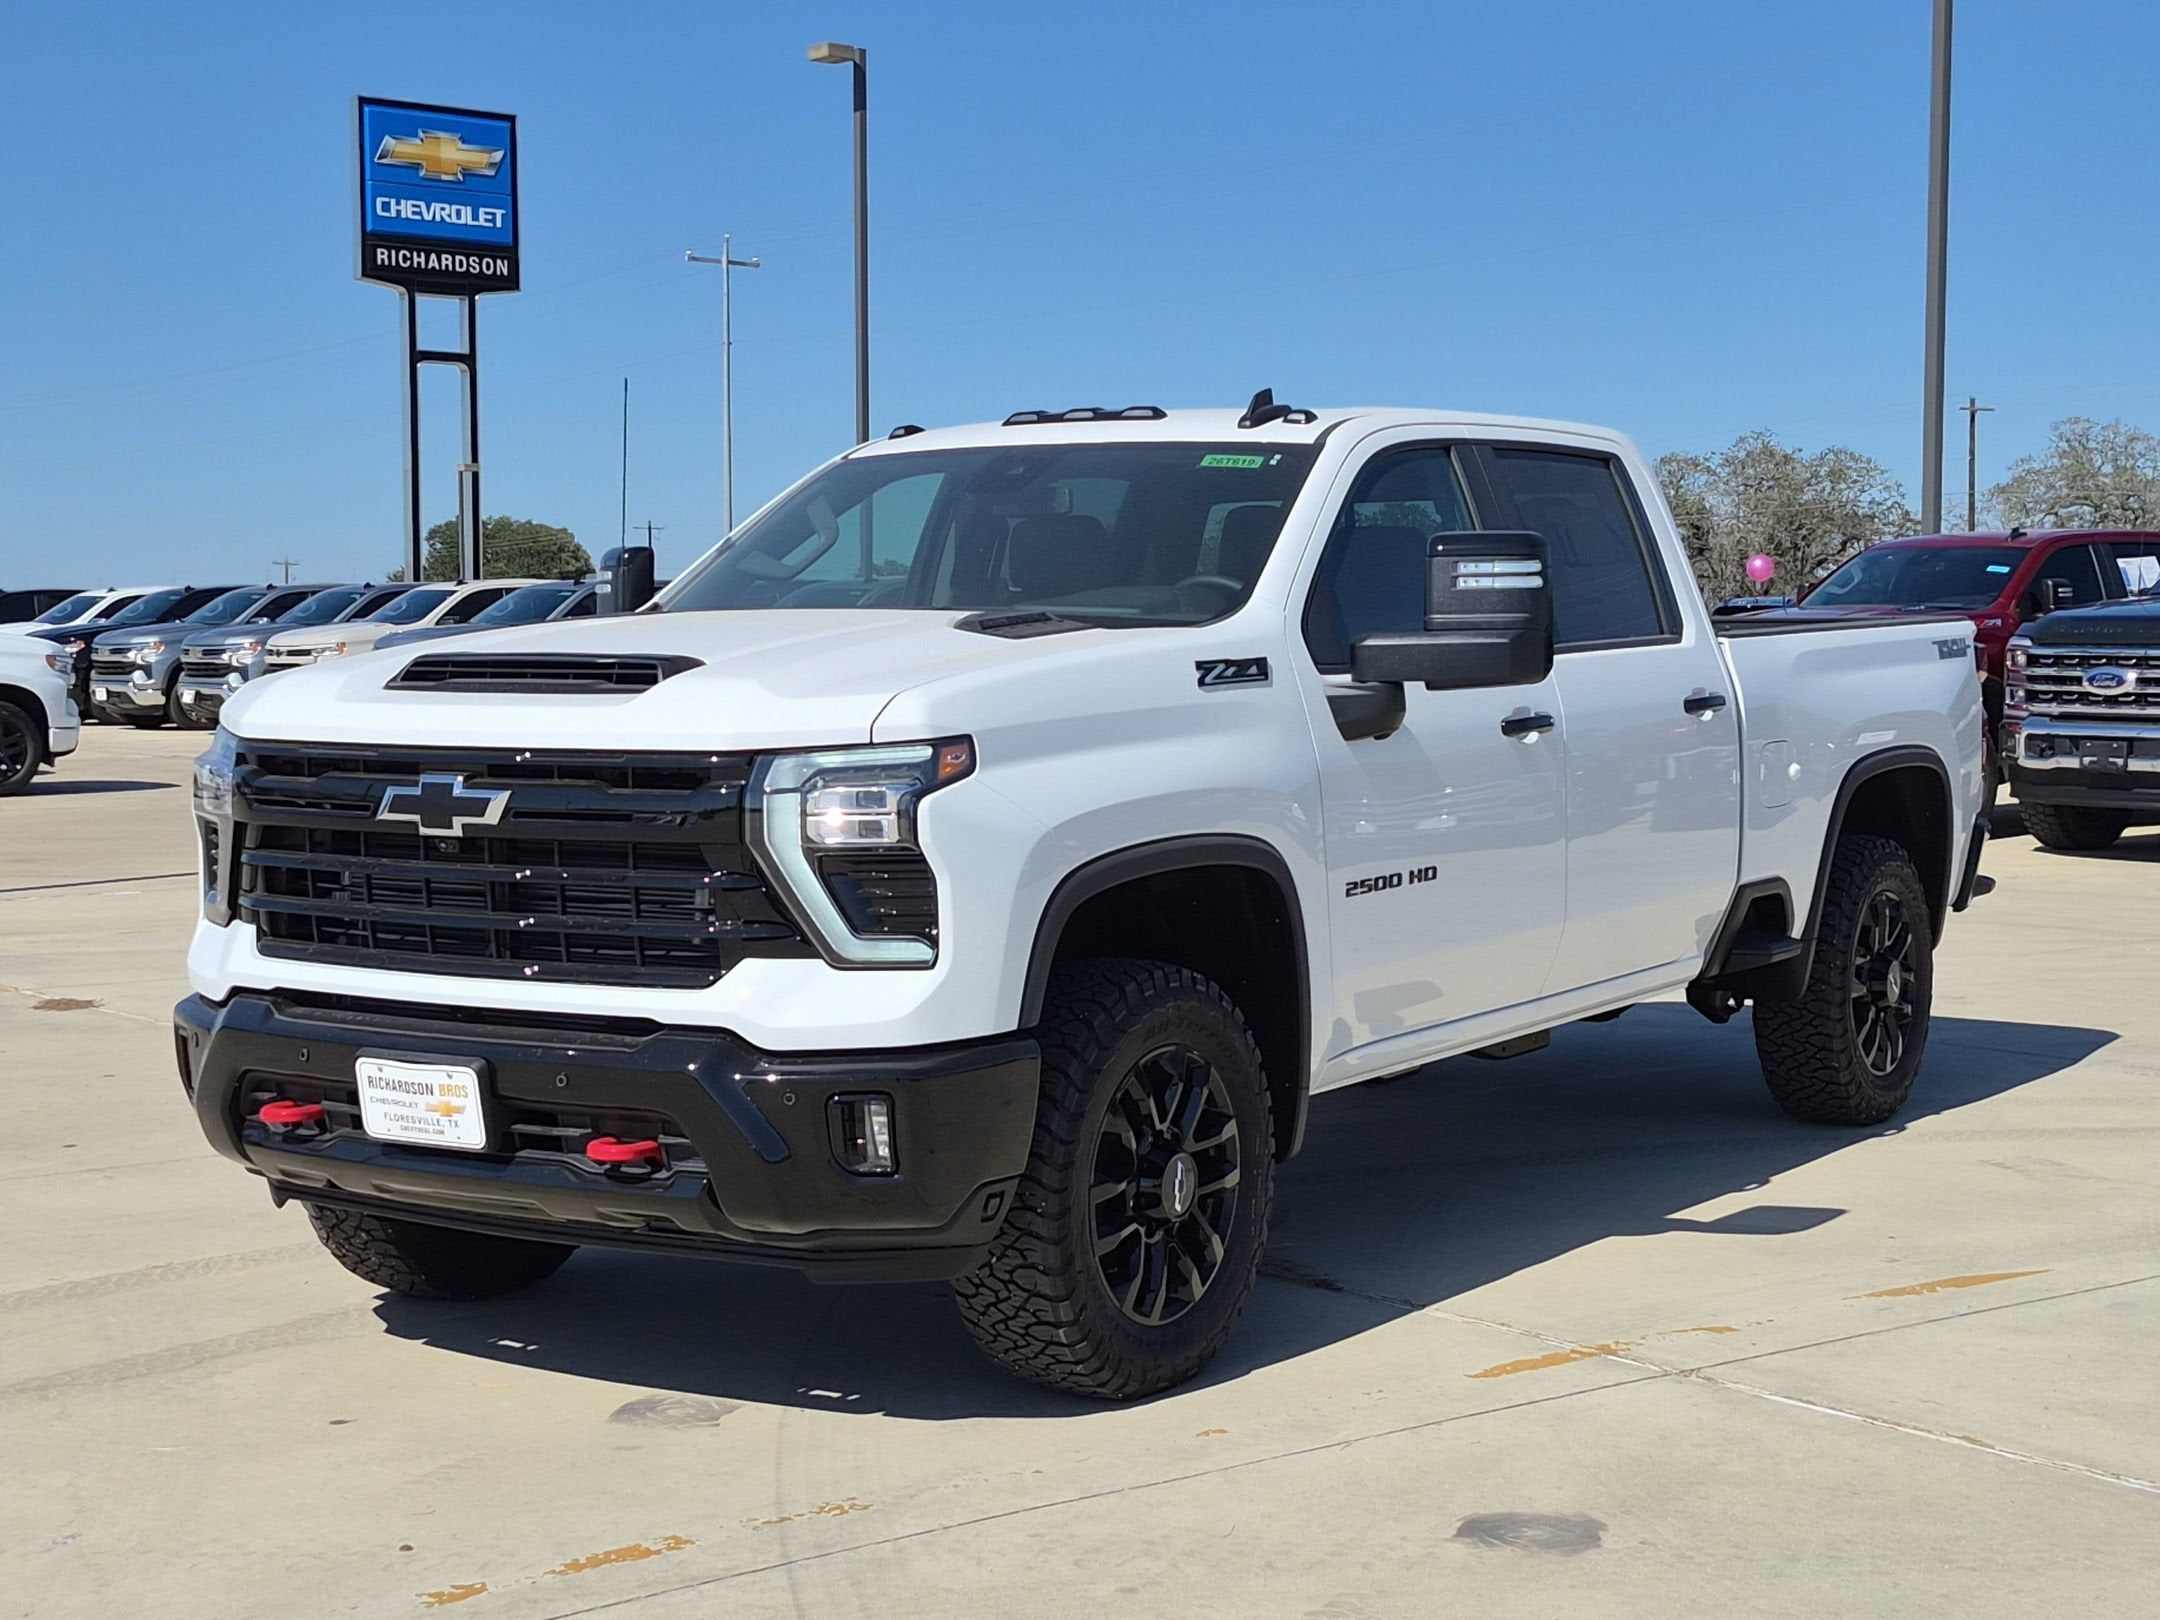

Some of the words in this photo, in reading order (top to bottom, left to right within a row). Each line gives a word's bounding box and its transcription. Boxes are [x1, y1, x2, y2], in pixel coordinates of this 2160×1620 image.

[376, 197, 506, 228] CHEVROLET
[376, 248, 508, 276] RICHARDSON
[1345, 872, 1403, 898] 2500
[1408, 865, 1437, 885] HD
[367, 1075, 434, 1097] RICHARDSON
[438, 1083, 469, 1099] BROS
[370, 1096, 419, 1110] CHEVROLET
[448, 1119, 460, 1129] TX
